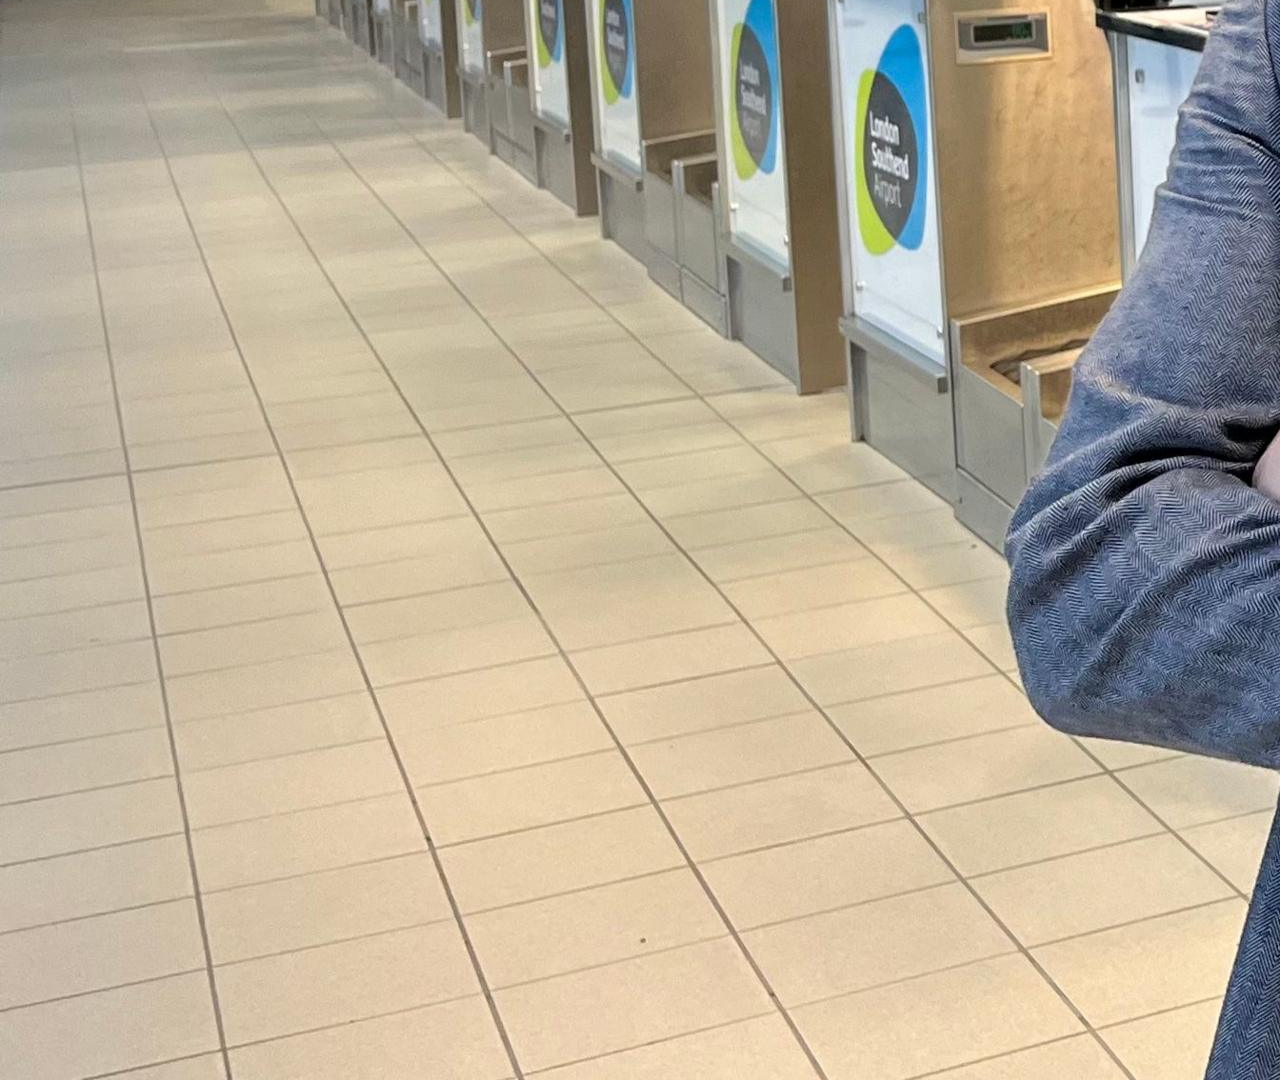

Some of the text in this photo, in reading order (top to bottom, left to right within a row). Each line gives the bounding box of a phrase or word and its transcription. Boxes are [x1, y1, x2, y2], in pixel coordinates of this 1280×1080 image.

[869, 110, 900, 146] London
[871, 141, 909, 181] Southend
[874, 171, 902, 208] Airport
